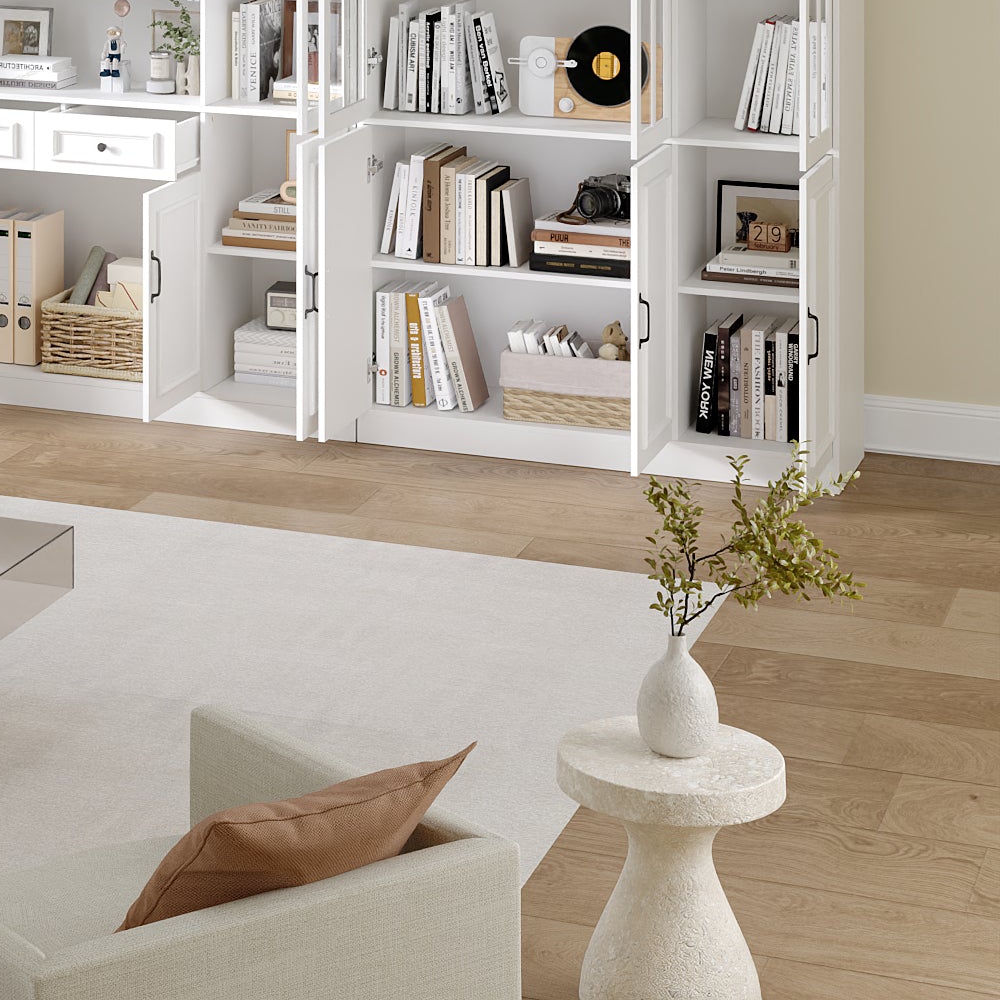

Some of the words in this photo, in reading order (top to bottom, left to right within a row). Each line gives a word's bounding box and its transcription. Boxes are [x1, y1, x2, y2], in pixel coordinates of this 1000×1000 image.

[409, 32, 417, 59] CUBISM
[482, 60, 492, 87] Berkel
[274, 206, 290, 215] STILL
[242, 222, 267, 230] VANITY
[736, 267, 767, 275] Lindbergh
[409, 323, 419, 335] arts
[411, 343, 422, 379] architecture
[451, 361, 459, 383] GROWN
[457, 383, 468, 412] ALCHEMIS
